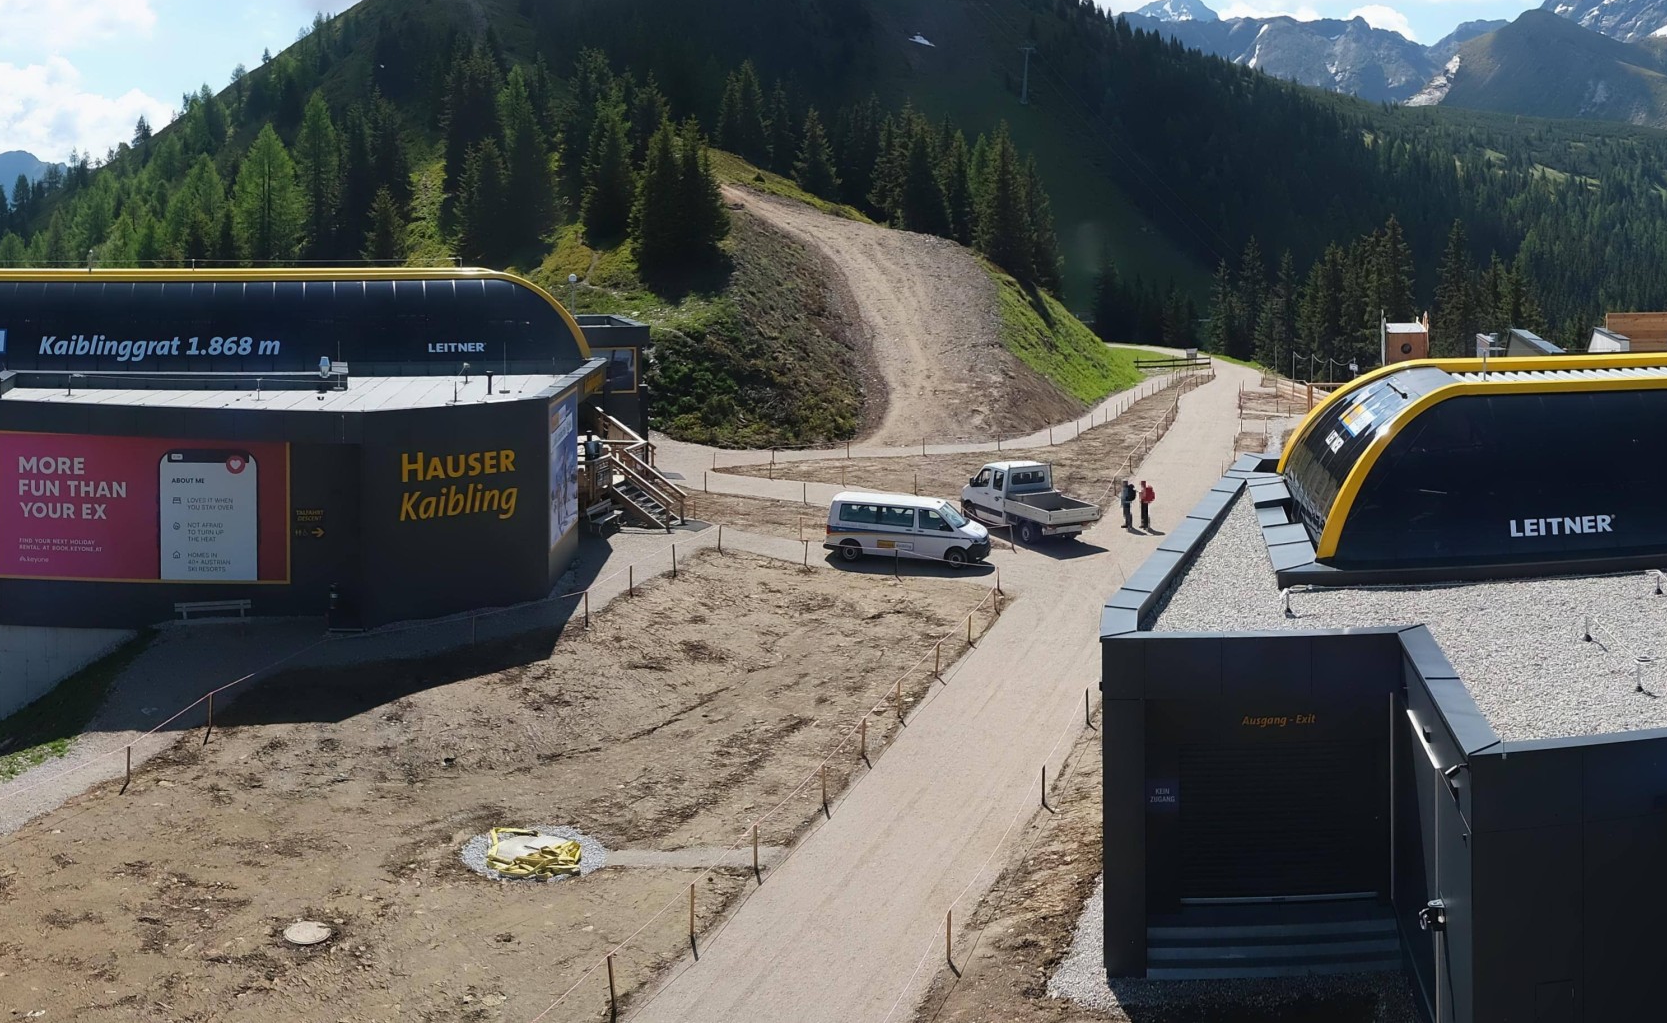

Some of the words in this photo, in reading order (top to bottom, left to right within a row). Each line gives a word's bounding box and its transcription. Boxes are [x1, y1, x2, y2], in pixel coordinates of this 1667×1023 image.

[39, 335, 180, 361] Kaiblinggrat
[186, 336, 252, 355] 1.868
[258, 340, 280, 355] m
[428, 343, 485, 353] LEITNER
[18, 456, 85, 475] MORE
[401, 449, 516, 483] HAUSER
[18, 479, 60, 497] FUN
[67, 480, 127, 498] THAN
[20, 502, 75, 519] YOUR
[82, 503, 107, 520] EX
[400, 483, 518, 522] Kaibling
[1509, 514, 1613, 538] LEITNER
[1242, 715, 1287, 728] Ausgang
[1295, 714, 1316, 724] Exit
[1149, 795, 1176, 803] ZUGANG
